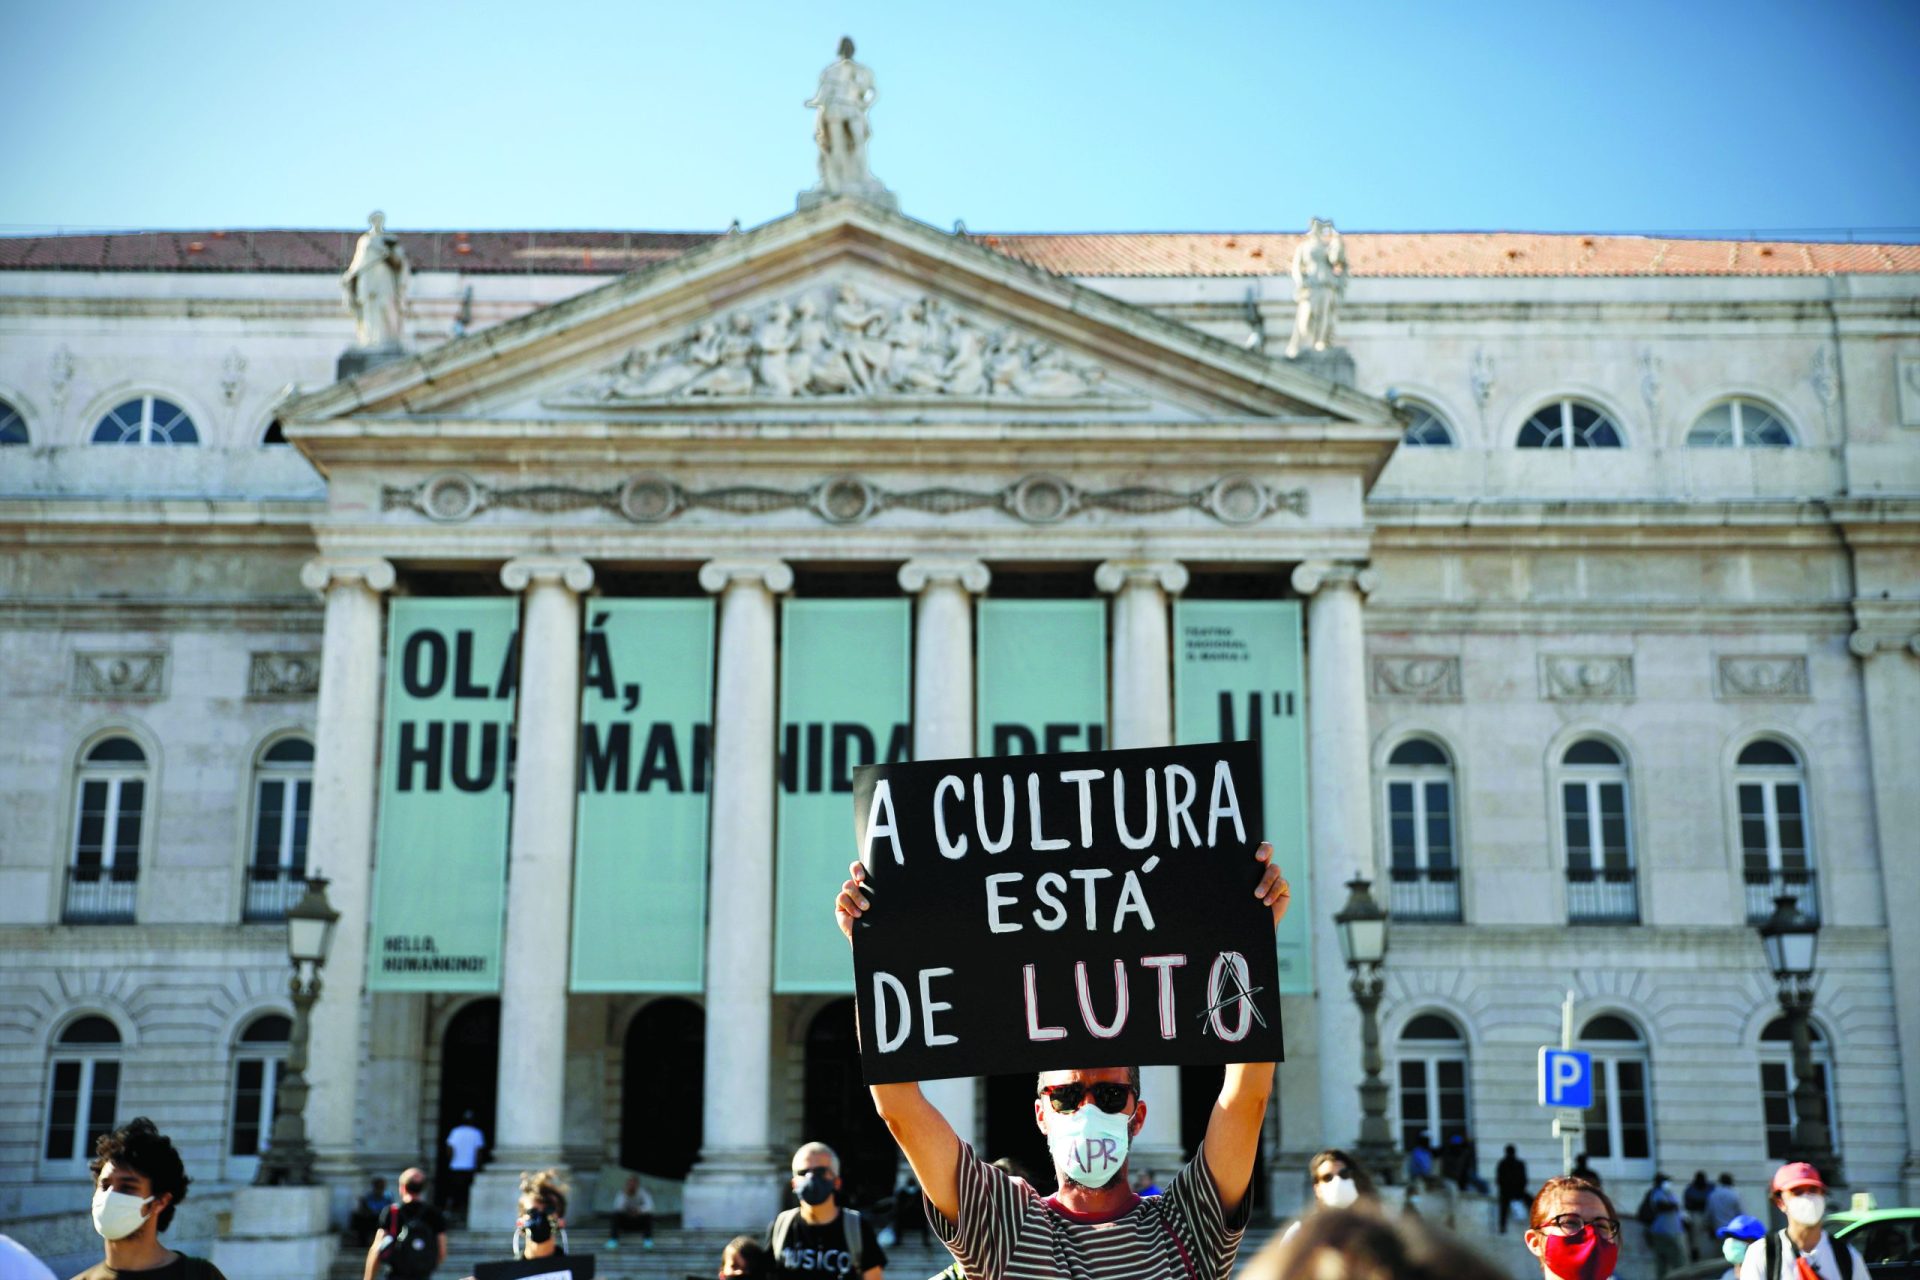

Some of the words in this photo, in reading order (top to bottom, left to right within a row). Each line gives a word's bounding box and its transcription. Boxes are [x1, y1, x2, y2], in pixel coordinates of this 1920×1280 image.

[863, 779, 904, 865] A
[933, 760, 1246, 860] CULTURA
[985, 855, 1160, 934] ESTÁ
[873, 966, 959, 1053] DE
[1552, 1054, 1582, 1101] P
[1067, 1138, 1118, 1173] APR
